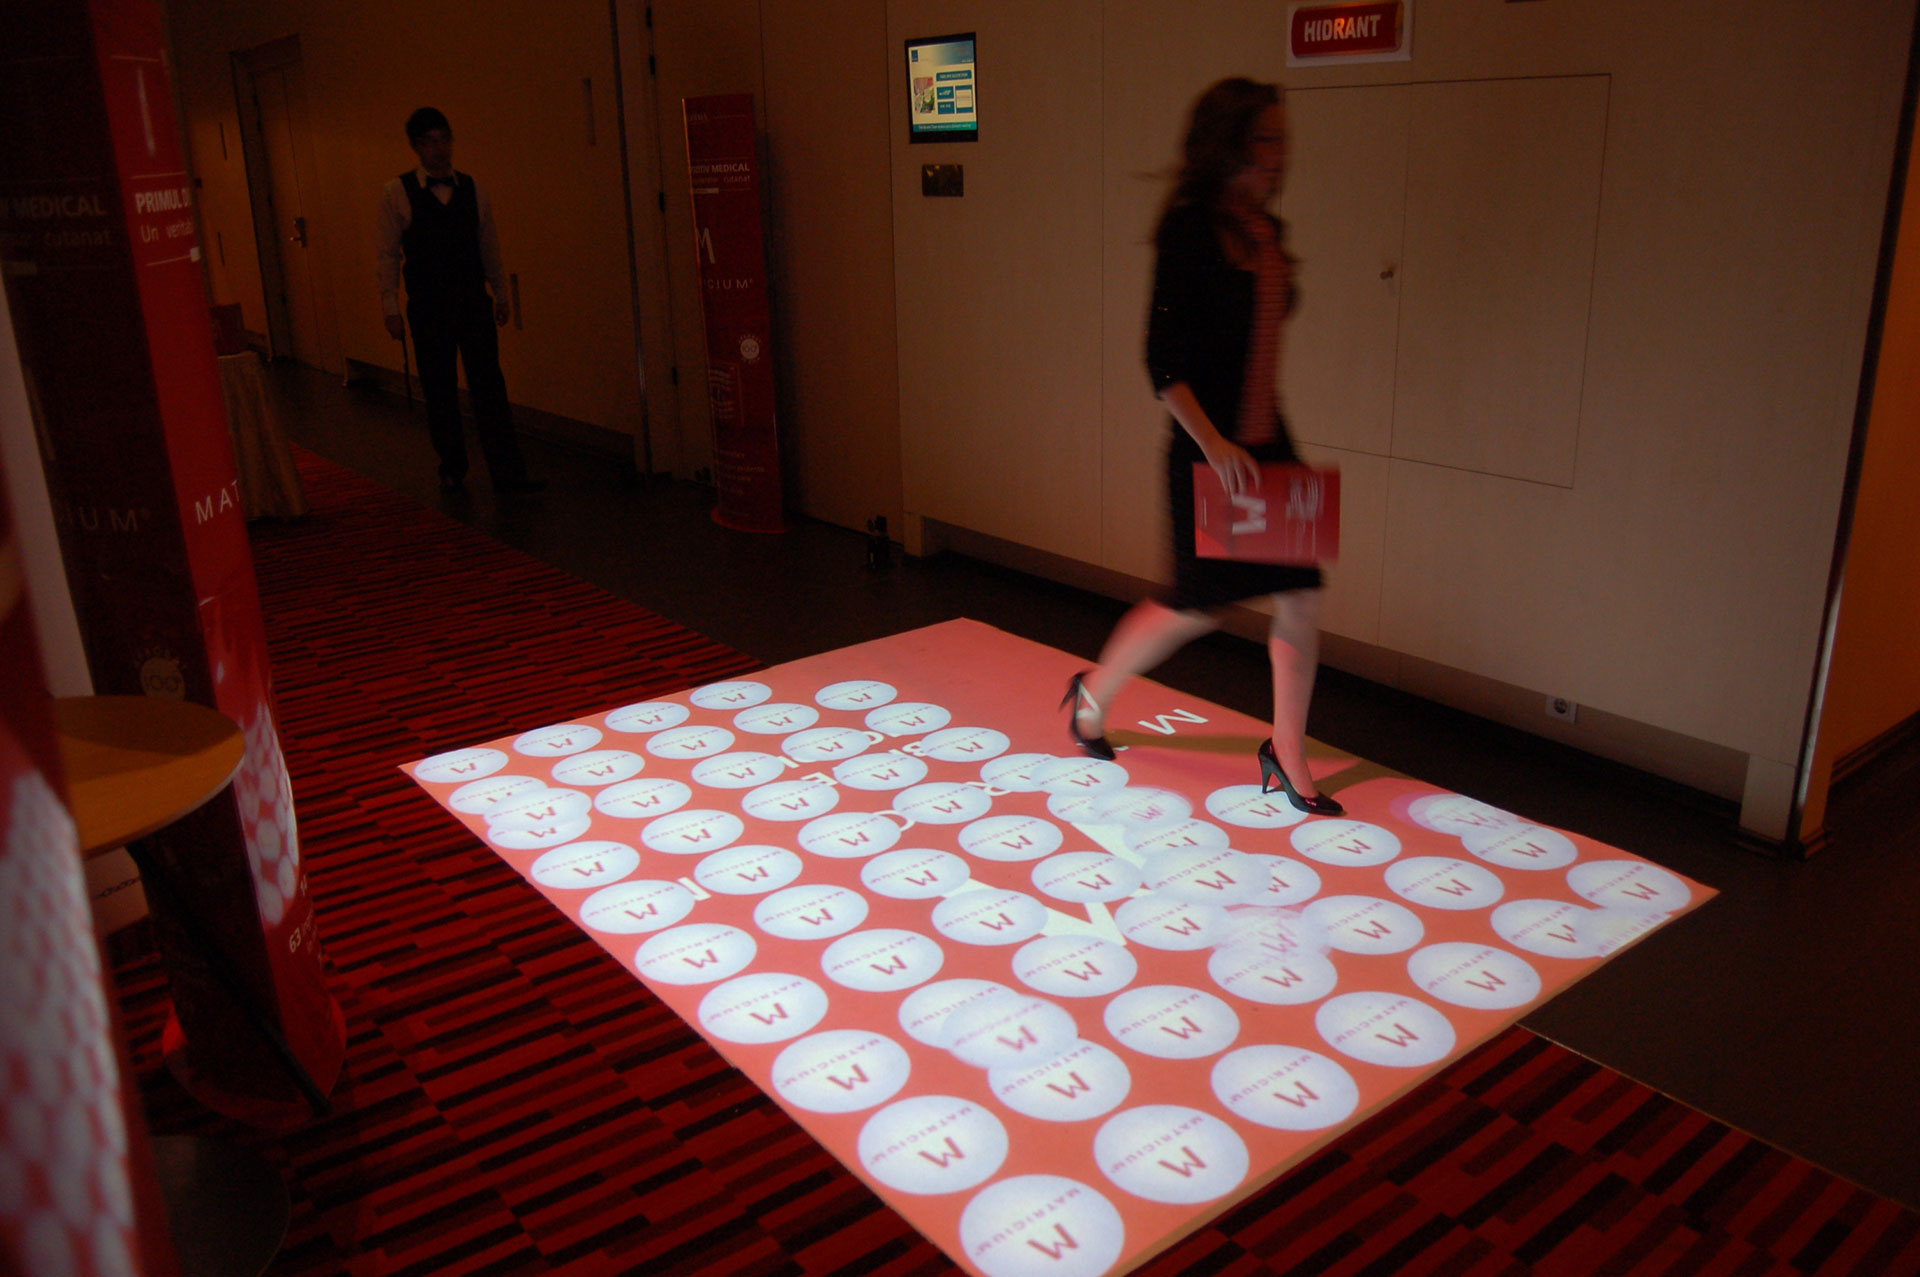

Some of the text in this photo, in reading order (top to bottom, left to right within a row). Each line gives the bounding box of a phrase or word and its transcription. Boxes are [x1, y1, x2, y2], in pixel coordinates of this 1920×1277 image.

[1304, 14, 1381, 42] HIDRANT
[711, 163, 751, 173] MEDICAL
[11, 194, 107, 219] MEDICAL
[135, 188, 182, 215] PRIMUL
[1426, 949, 1495, 990] MATRICIUM
[706, 981, 803, 1023] MATRICIUM
[910, 986, 999, 1028] MATRICIUM
[1119, 993, 1200, 1036] MATRICIUM
[1335, 1000, 1408, 1044] MATRICIUM
[780, 1038, 881, 1088] MATRICIUM
[1002, 1046, 1093, 1094] MATRICIUM
[1230, 1054, 1311, 1104] MATRICIUM
[870, 1107, 973, 1166] MATRICIUM
[1110, 1116, 1204, 1174] MATRICIUM
[975, 1187, 1081, 1256] MATRICIUM
